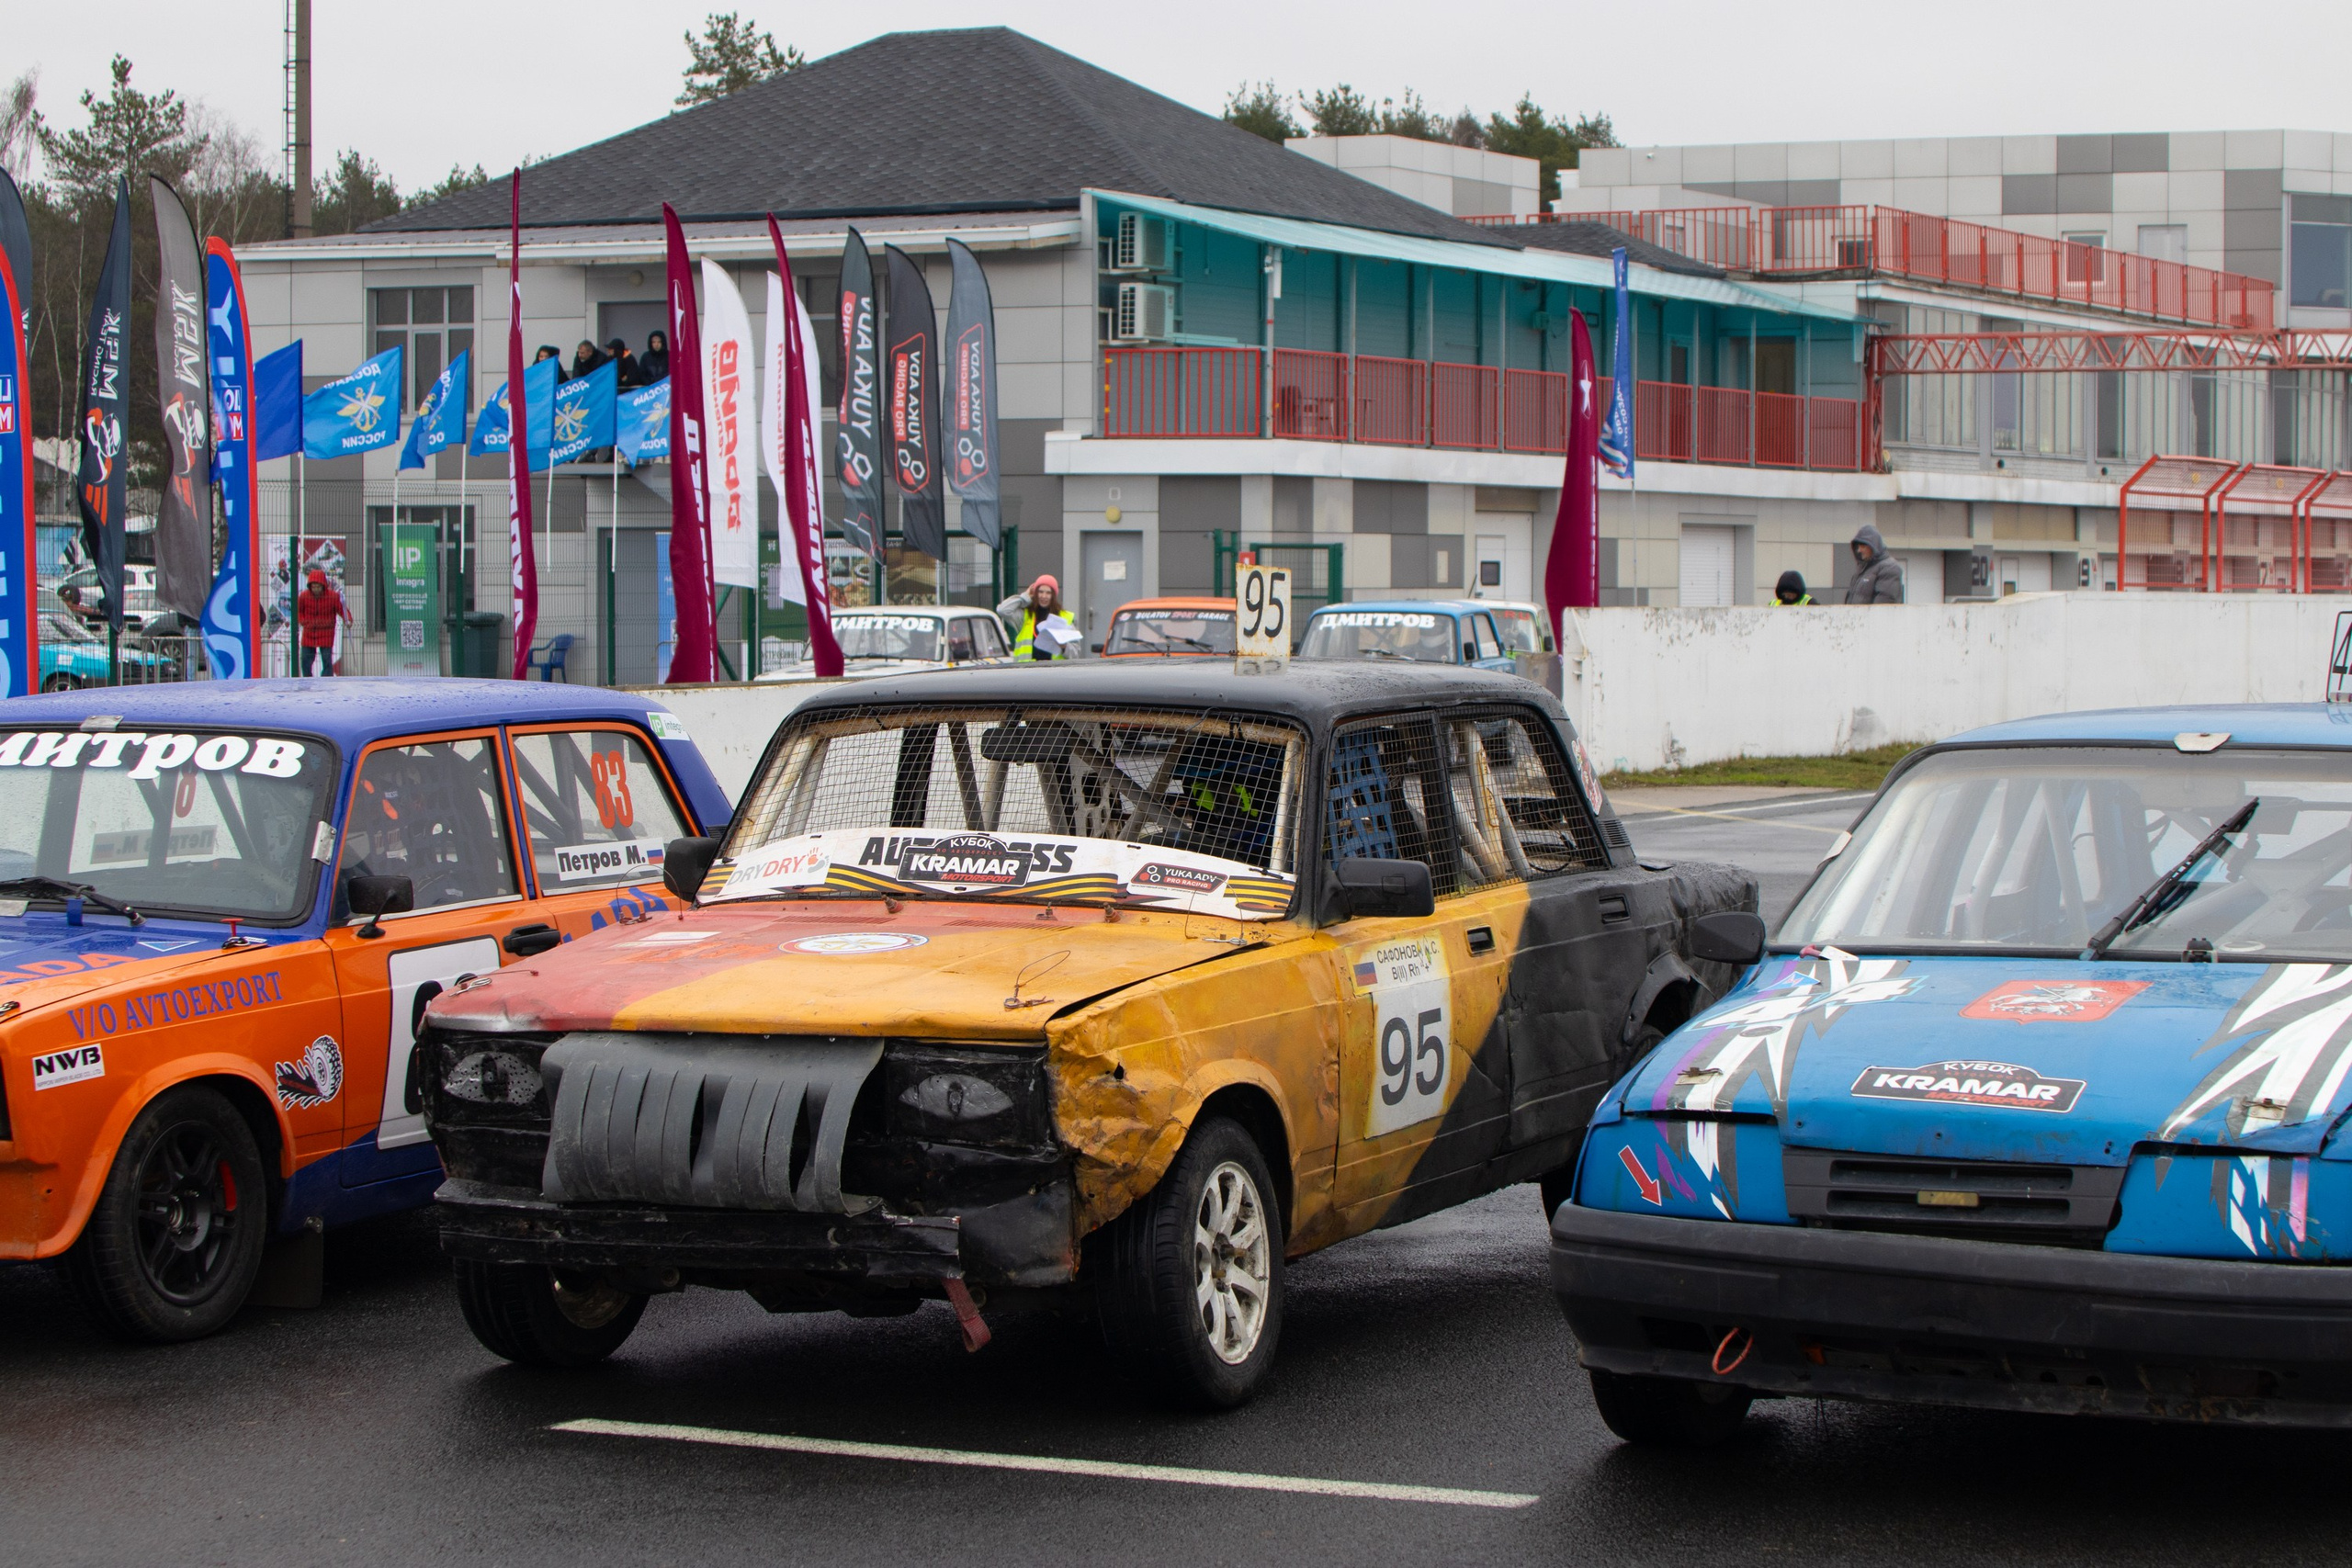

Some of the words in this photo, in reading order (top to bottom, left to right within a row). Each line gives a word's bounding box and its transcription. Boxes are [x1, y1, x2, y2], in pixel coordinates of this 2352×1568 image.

[1243, 570, 1286, 638] 95
[1136, 612, 1170, 620] BULATOV
[1197, 612, 1230, 621] GARAGE
[1319, 613, 1435, 630] ДМИТРОВ
[591, 750, 634, 829] 83
[950, 837, 996, 850] КУБОК
[558, 851, 621, 874] Петров
[626, 845, 646, 864] М.
[910, 853, 1020, 875] KRAMAR
[941, 873, 1016, 883] MOTORSPORT
[1165, 868, 1193, 878] YUKA
[1194, 873, 1217, 883] ADV
[1182, 879, 1208, 888] RACING
[67, 1003, 118, 1039] V/O
[126, 971, 283, 1030] AVTOEXPORT
[35, 1046, 101, 1077] NWB
[1381, 1008, 1444, 1106] 95
[1944, 1063, 2019, 1076] КУБОК
[1873, 1073, 2061, 1101] KRAMAR
[1924, 1091, 2055, 1109] MOTORSPORT
